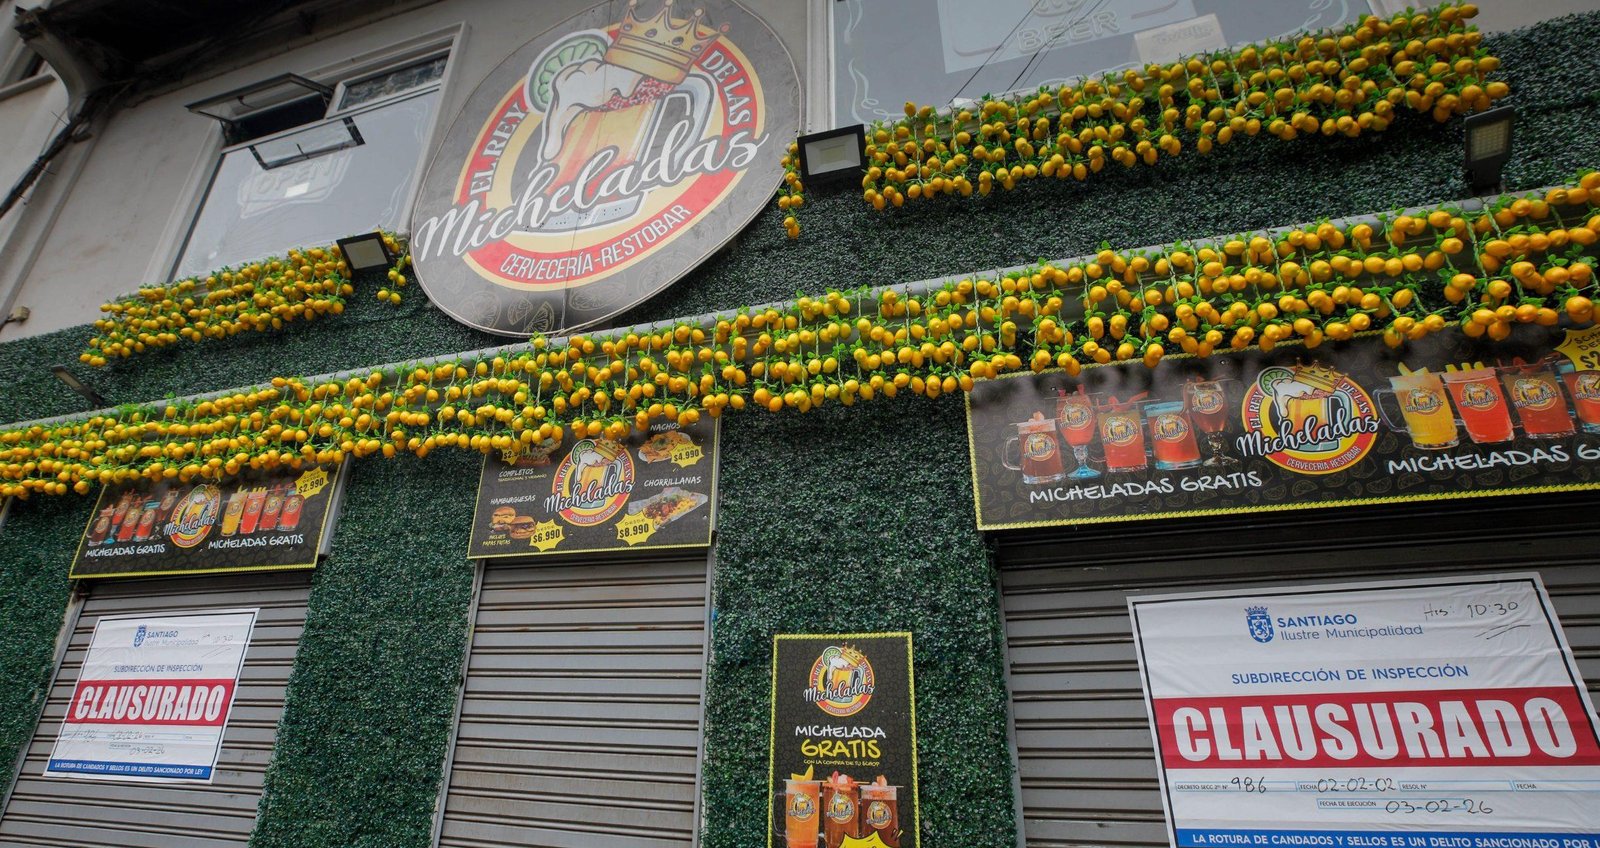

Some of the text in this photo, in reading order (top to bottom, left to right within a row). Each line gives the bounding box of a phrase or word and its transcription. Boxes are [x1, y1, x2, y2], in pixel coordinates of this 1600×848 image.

[1017, 10, 1119, 53] BEER
[701, 50, 750, 126] DE LAS
[470, 102, 526, 196] EL REY
[416, 120, 769, 262] Micheladas
[1341, 382, 1370, 414] DE LAS
[650, 423, 680, 431] NACHOS
[1236, 408, 1380, 456] Micheladas
[504, 446, 527, 460] $2.0
[674, 449, 699, 462] $4.990
[1388, 443, 1600, 474] MICHELADAS G
[499, 468, 534, 478] COMPLETOS
[644, 476, 701, 487] CHORRILLANAS
[298, 477, 324, 494] $2.990
[544, 474, 635, 513] Micheladas
[1030, 471, 1262, 503] MICHELADAS GRATIS
[490, 495, 536, 505] HAMBURGUESAS
[163, 502, 215, 536] Micheladas
[533, 529, 560, 543] $6.990
[620, 524, 648, 538] $8.990
[208, 536, 267, 549] MICHELADAS
[269, 534, 304, 547] GRATIS
[85, 544, 165, 558] MICHELADAS GRATIS
[1467, 601, 1518, 618] 10:30
[1277, 614, 1357, 628] SANTIAGO
[146, 631, 178, 639] SANTIAGO
[1281, 625, 1424, 640] Ilustre Municipalidad
[1232, 664, 1469, 684] SUBDIRECCIÓN DE INSPECCIÓN
[803, 677, 875, 702] Micheladas
[74, 684, 226, 722] CLAUSURADO
[795, 725, 886, 739] MICHELADA
[1172, 696, 1578, 762] CLAUSURADO
[801, 739, 881, 758] GRATIS
[1231, 776, 1266, 793] 986
[1318, 777, 1396, 793] 02-02-02
[1386, 799, 1493, 814] 03-02-26
[1192, 834, 1206, 843] LA
[1209, 835, 1250, 844] ROTURA
[1254, 835, 1268, 844] DE
[1272, 835, 1333, 845] CANDADOS
[1335, 836, 1343, 845] Y
[1347, 836, 1388, 846] SELLOS
[1393, 837, 1405, 846] ES
[1408, 837, 1426, 846] UN
[1430, 837, 1471, 847] DELITO
[1476, 837, 1559, 848] SANCIONADO
[1564, 839, 1589, 848] POR
